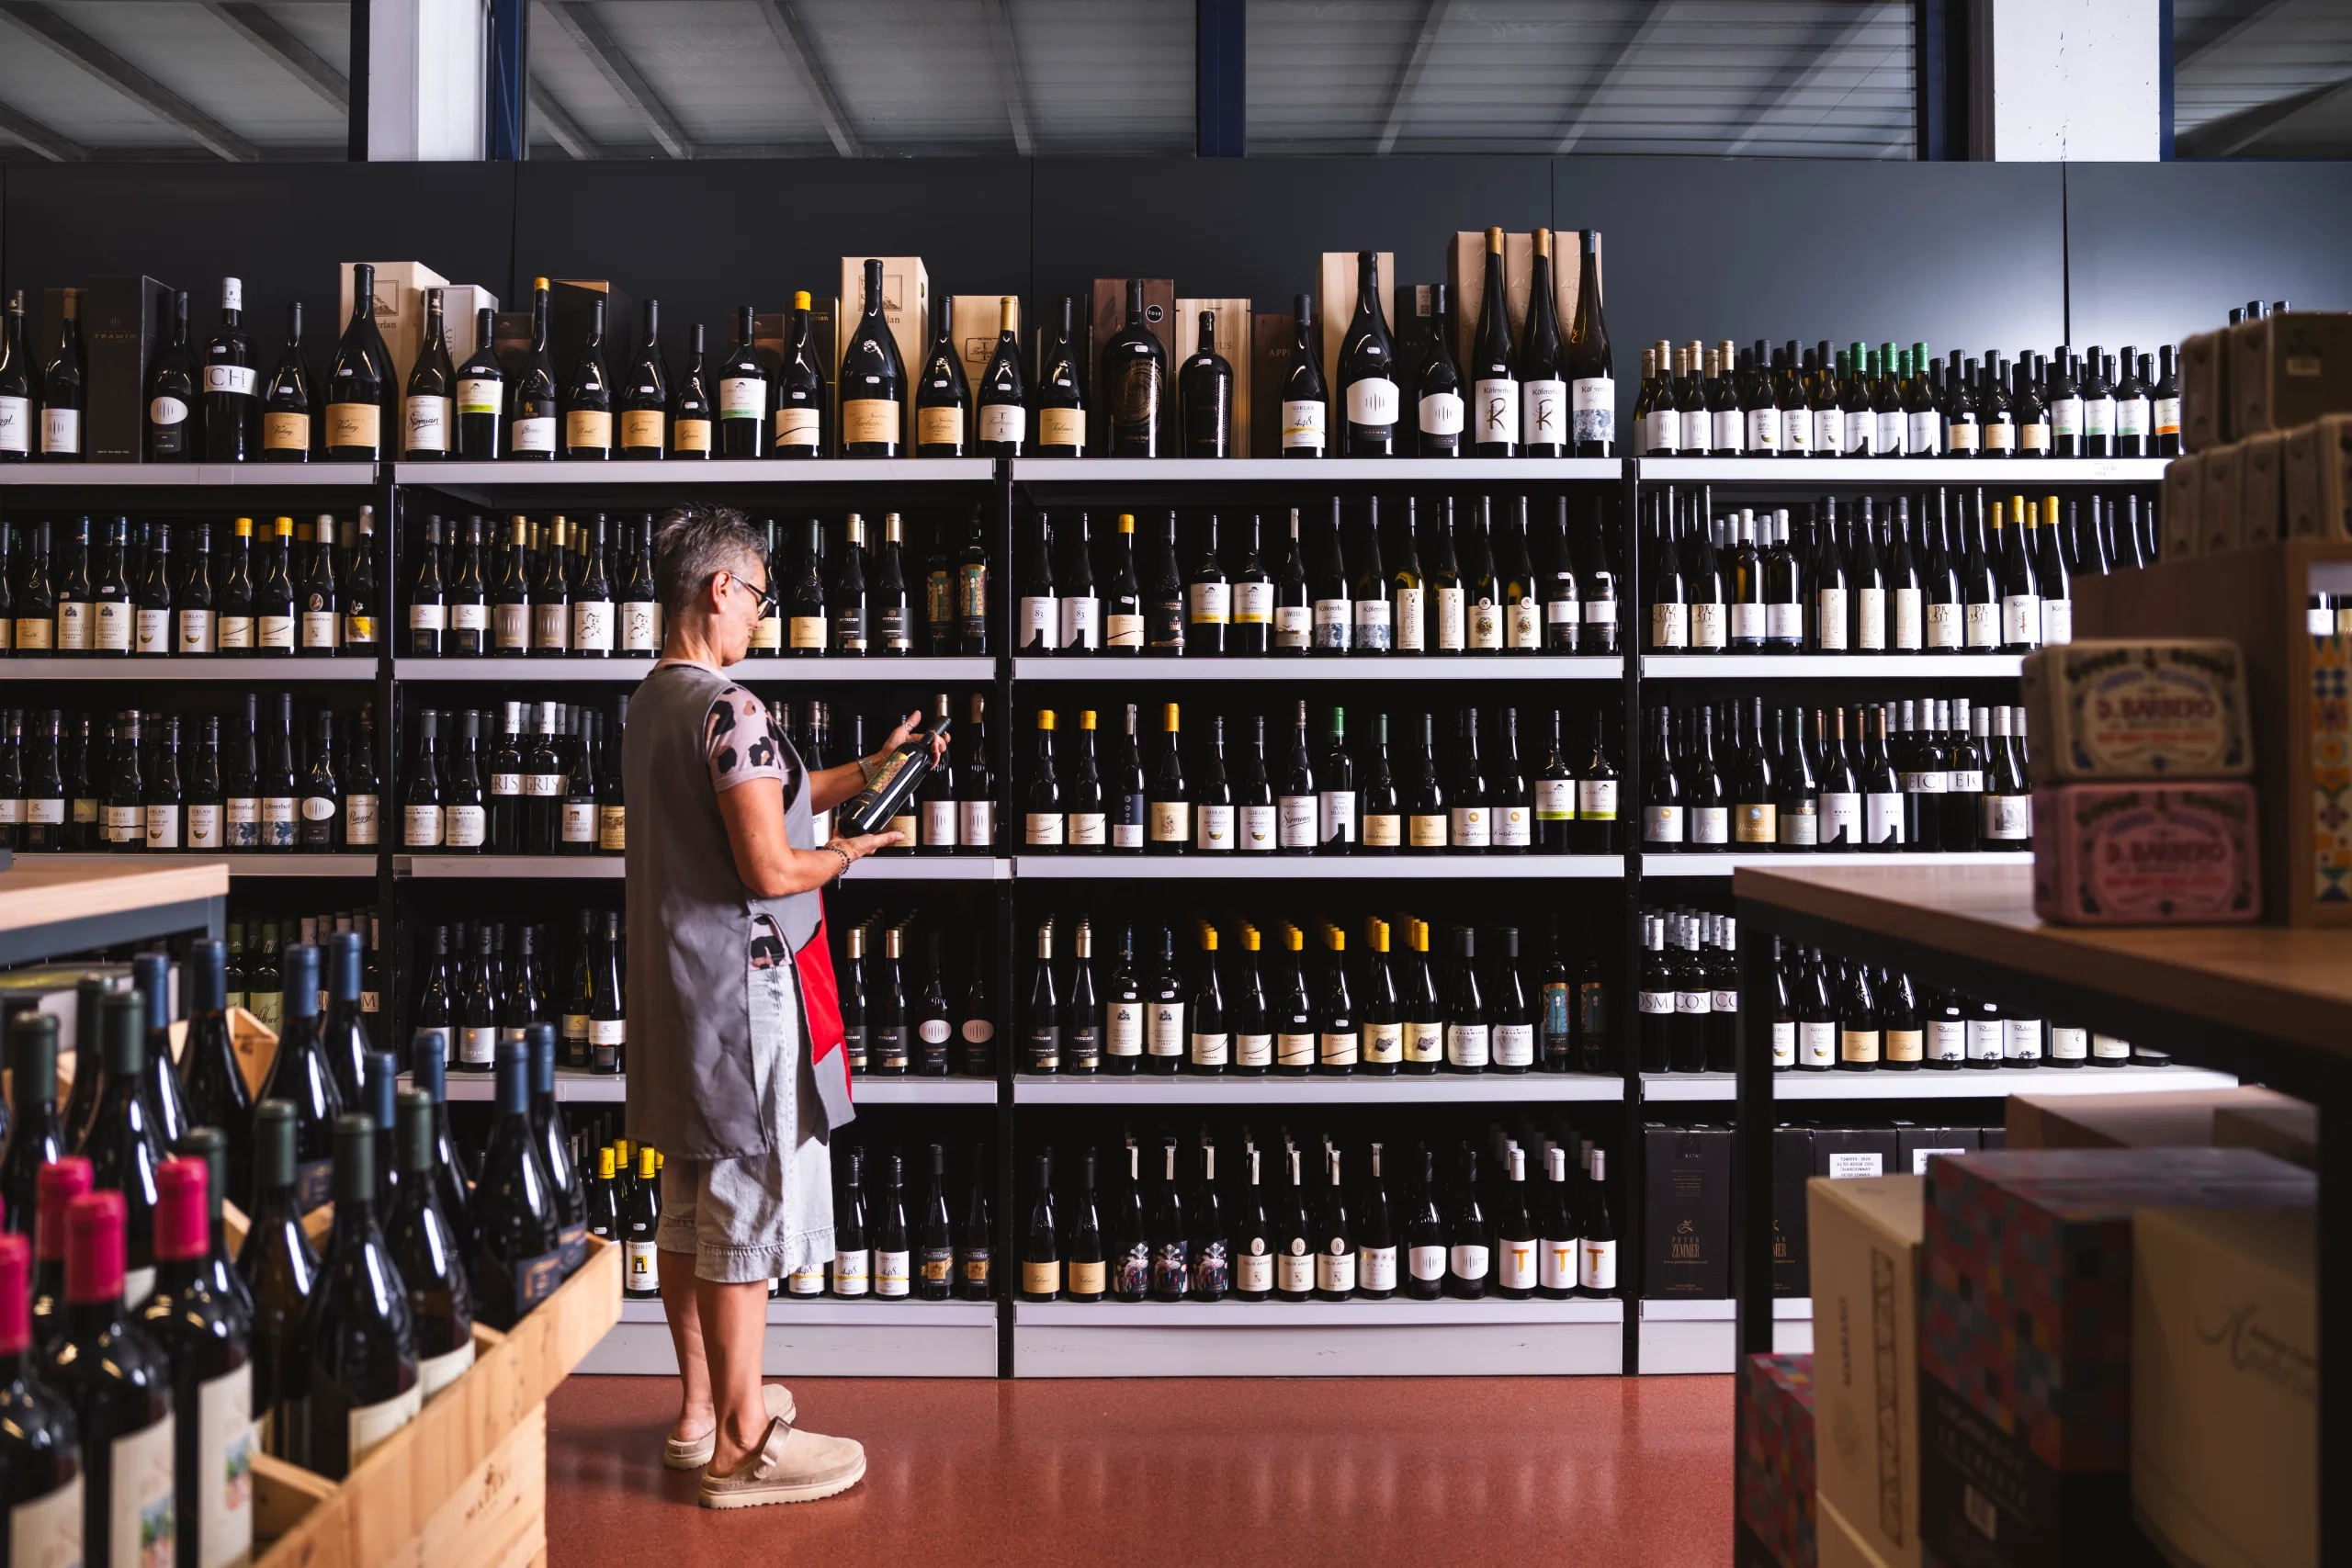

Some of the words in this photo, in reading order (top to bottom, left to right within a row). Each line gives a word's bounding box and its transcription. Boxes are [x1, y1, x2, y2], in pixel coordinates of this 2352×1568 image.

[375, 321, 396, 329] erlan
[205, 367, 246, 388] ICH
[408, 412, 439, 432] Sirmian
[1035, 609, 1045, 620] 83
[1079, 609, 1088, 620] 83
[349, 811, 375, 826] Punggl
[1281, 811, 1311, 829] Sirmian
[1676, 994, 1707, 1009] COS
[1716, 993, 1737, 1008] CO
[1671, 1243, 1700, 1258] ZEMMER
[1511, 1249, 1530, 1272] T
[1553, 1249, 1570, 1272] T
[1586, 1248, 1604, 1272] T
